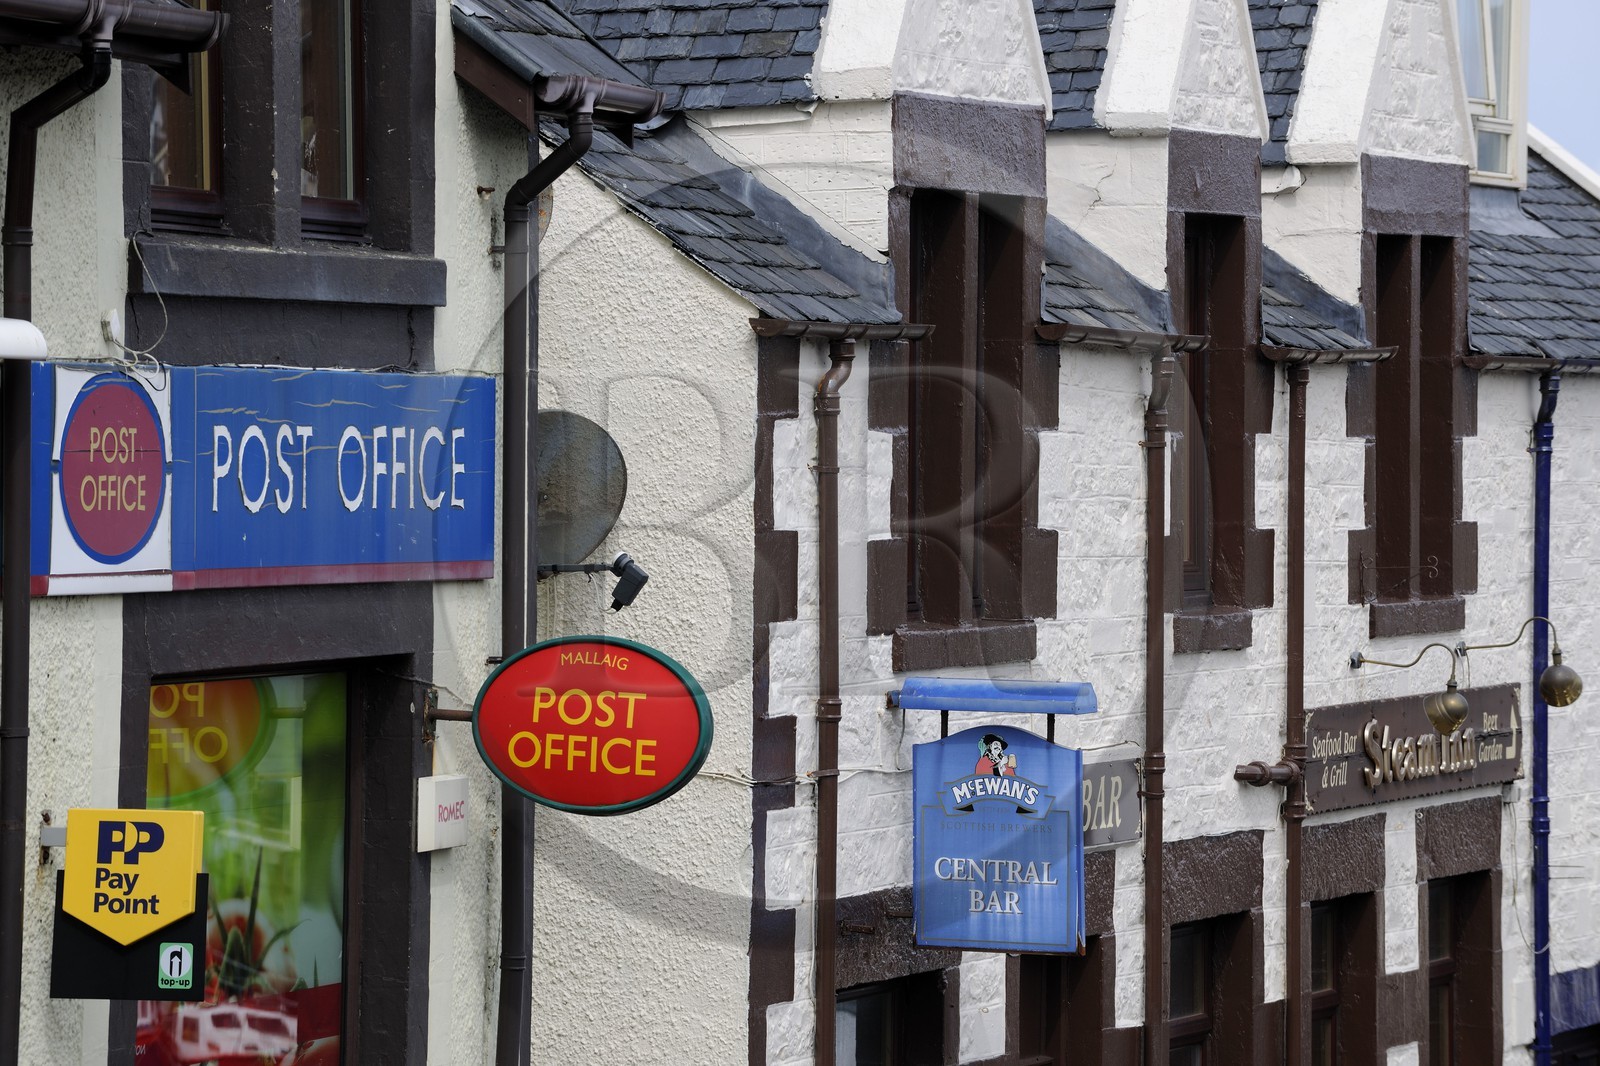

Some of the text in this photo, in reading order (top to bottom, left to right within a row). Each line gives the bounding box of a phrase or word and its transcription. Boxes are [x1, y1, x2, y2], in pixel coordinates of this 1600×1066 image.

[89, 426, 136, 464] POST
[212, 424, 465, 514] POST OFFICE
[80, 474, 146, 512] OFFICE
[560, 651, 630, 671] MALLAIG
[532, 686, 647, 729] POST
[1482, 711, 1499, 732] Beer
[507, 730, 657, 777] OFFICE
[1311, 729, 1358, 764] Seafood Bar
[1364, 718, 1477, 789] Steam Inn
[1478, 738, 1503, 763] Garden
[1321, 761, 1348, 789] & Grill
[1082, 775, 1123, 832] BAR
[95, 867, 139, 896] Pay
[934, 856, 1058, 886] CENTRAL
[93, 892, 160, 915] Point
[969, 889, 1023, 915] BAR
[160, 977, 191, 987] top-up
